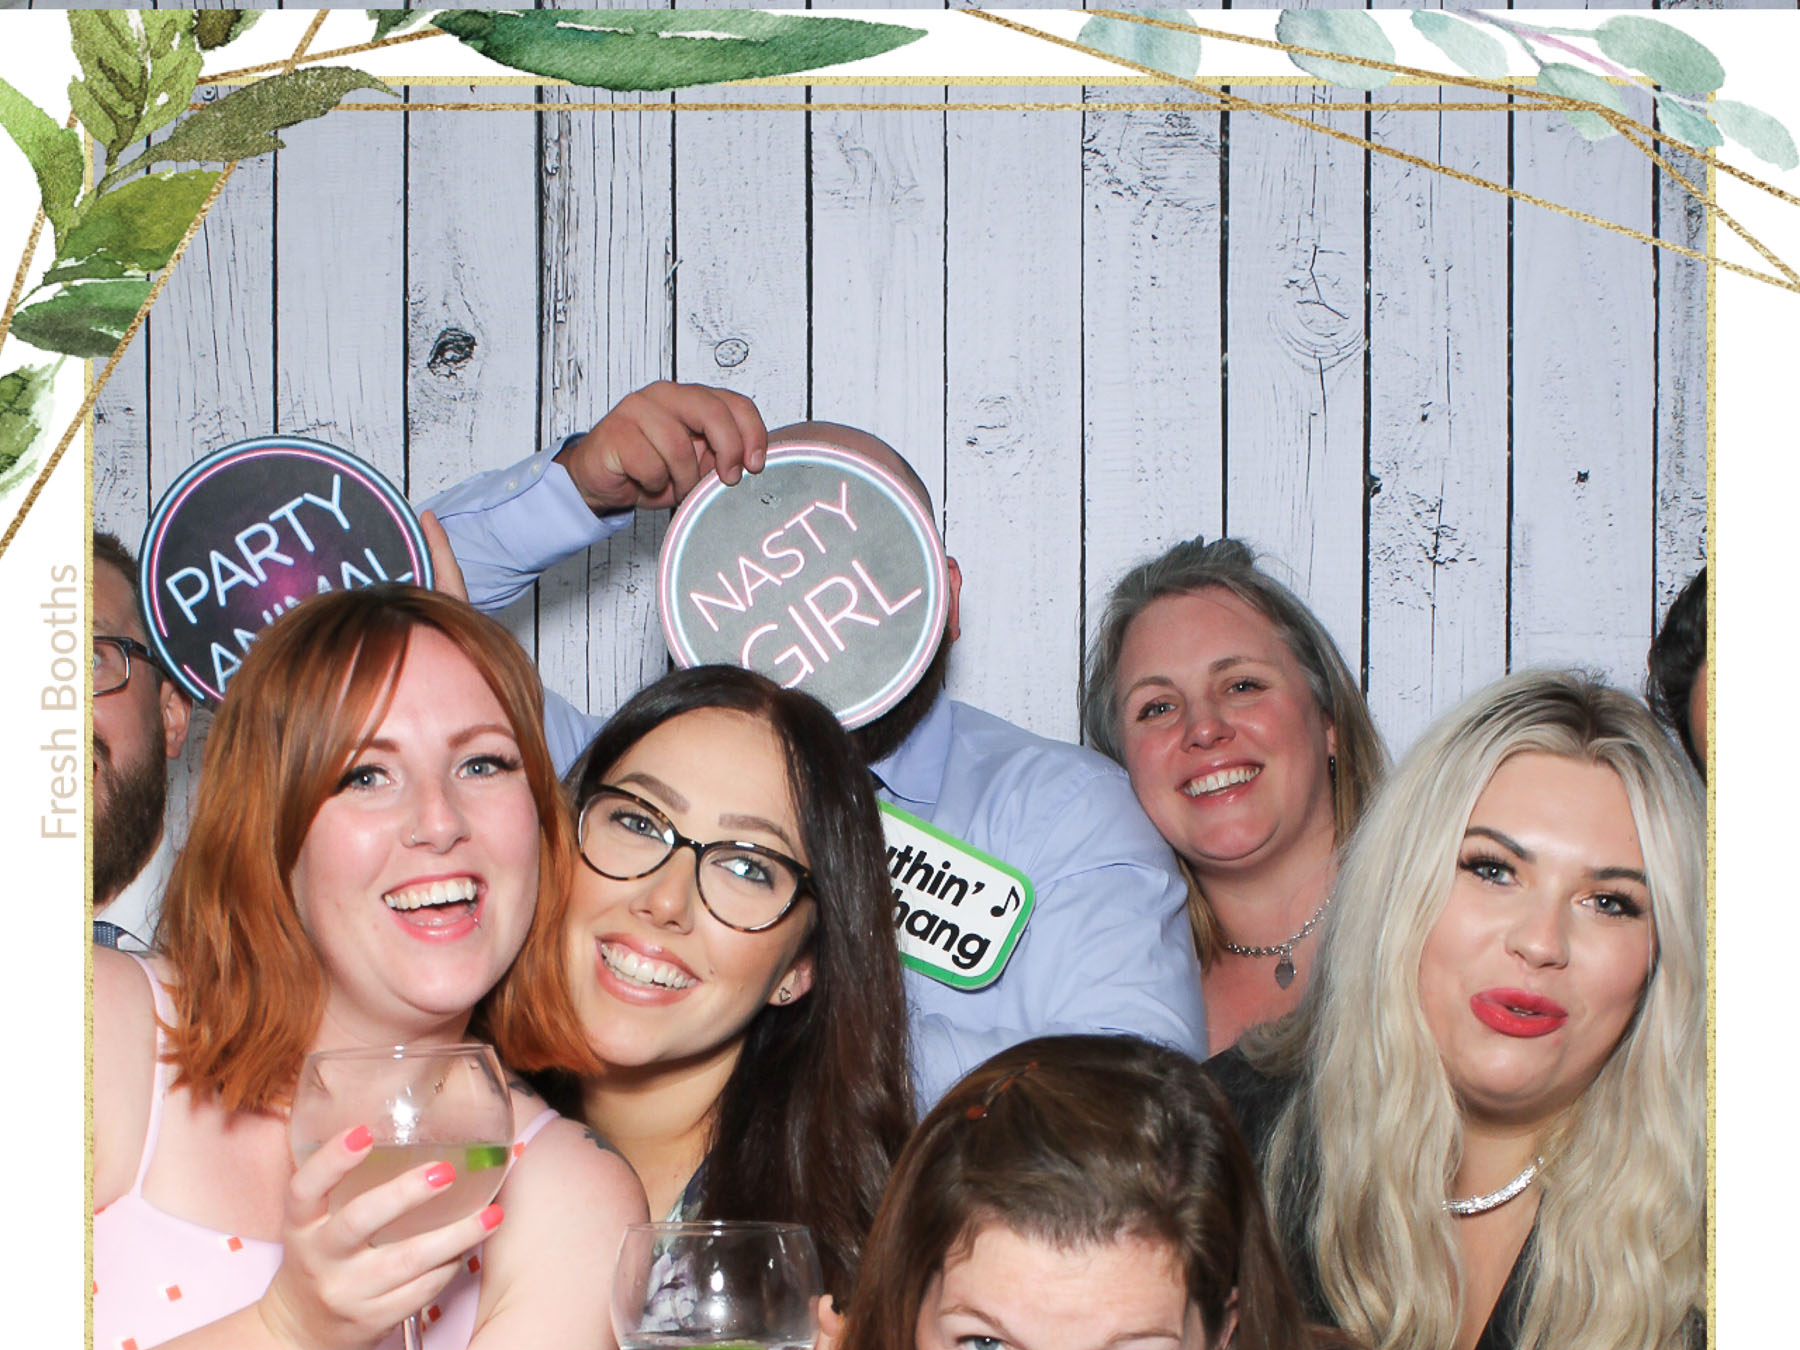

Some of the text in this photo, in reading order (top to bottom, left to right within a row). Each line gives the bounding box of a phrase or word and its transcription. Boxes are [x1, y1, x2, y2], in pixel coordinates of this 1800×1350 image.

[166, 473, 351, 624] PARTY
[689, 481, 858, 632] NASTY
[741, 559, 923, 689] GIRL
[886, 845, 986, 907] thin'
[893, 888, 992, 970] hang
